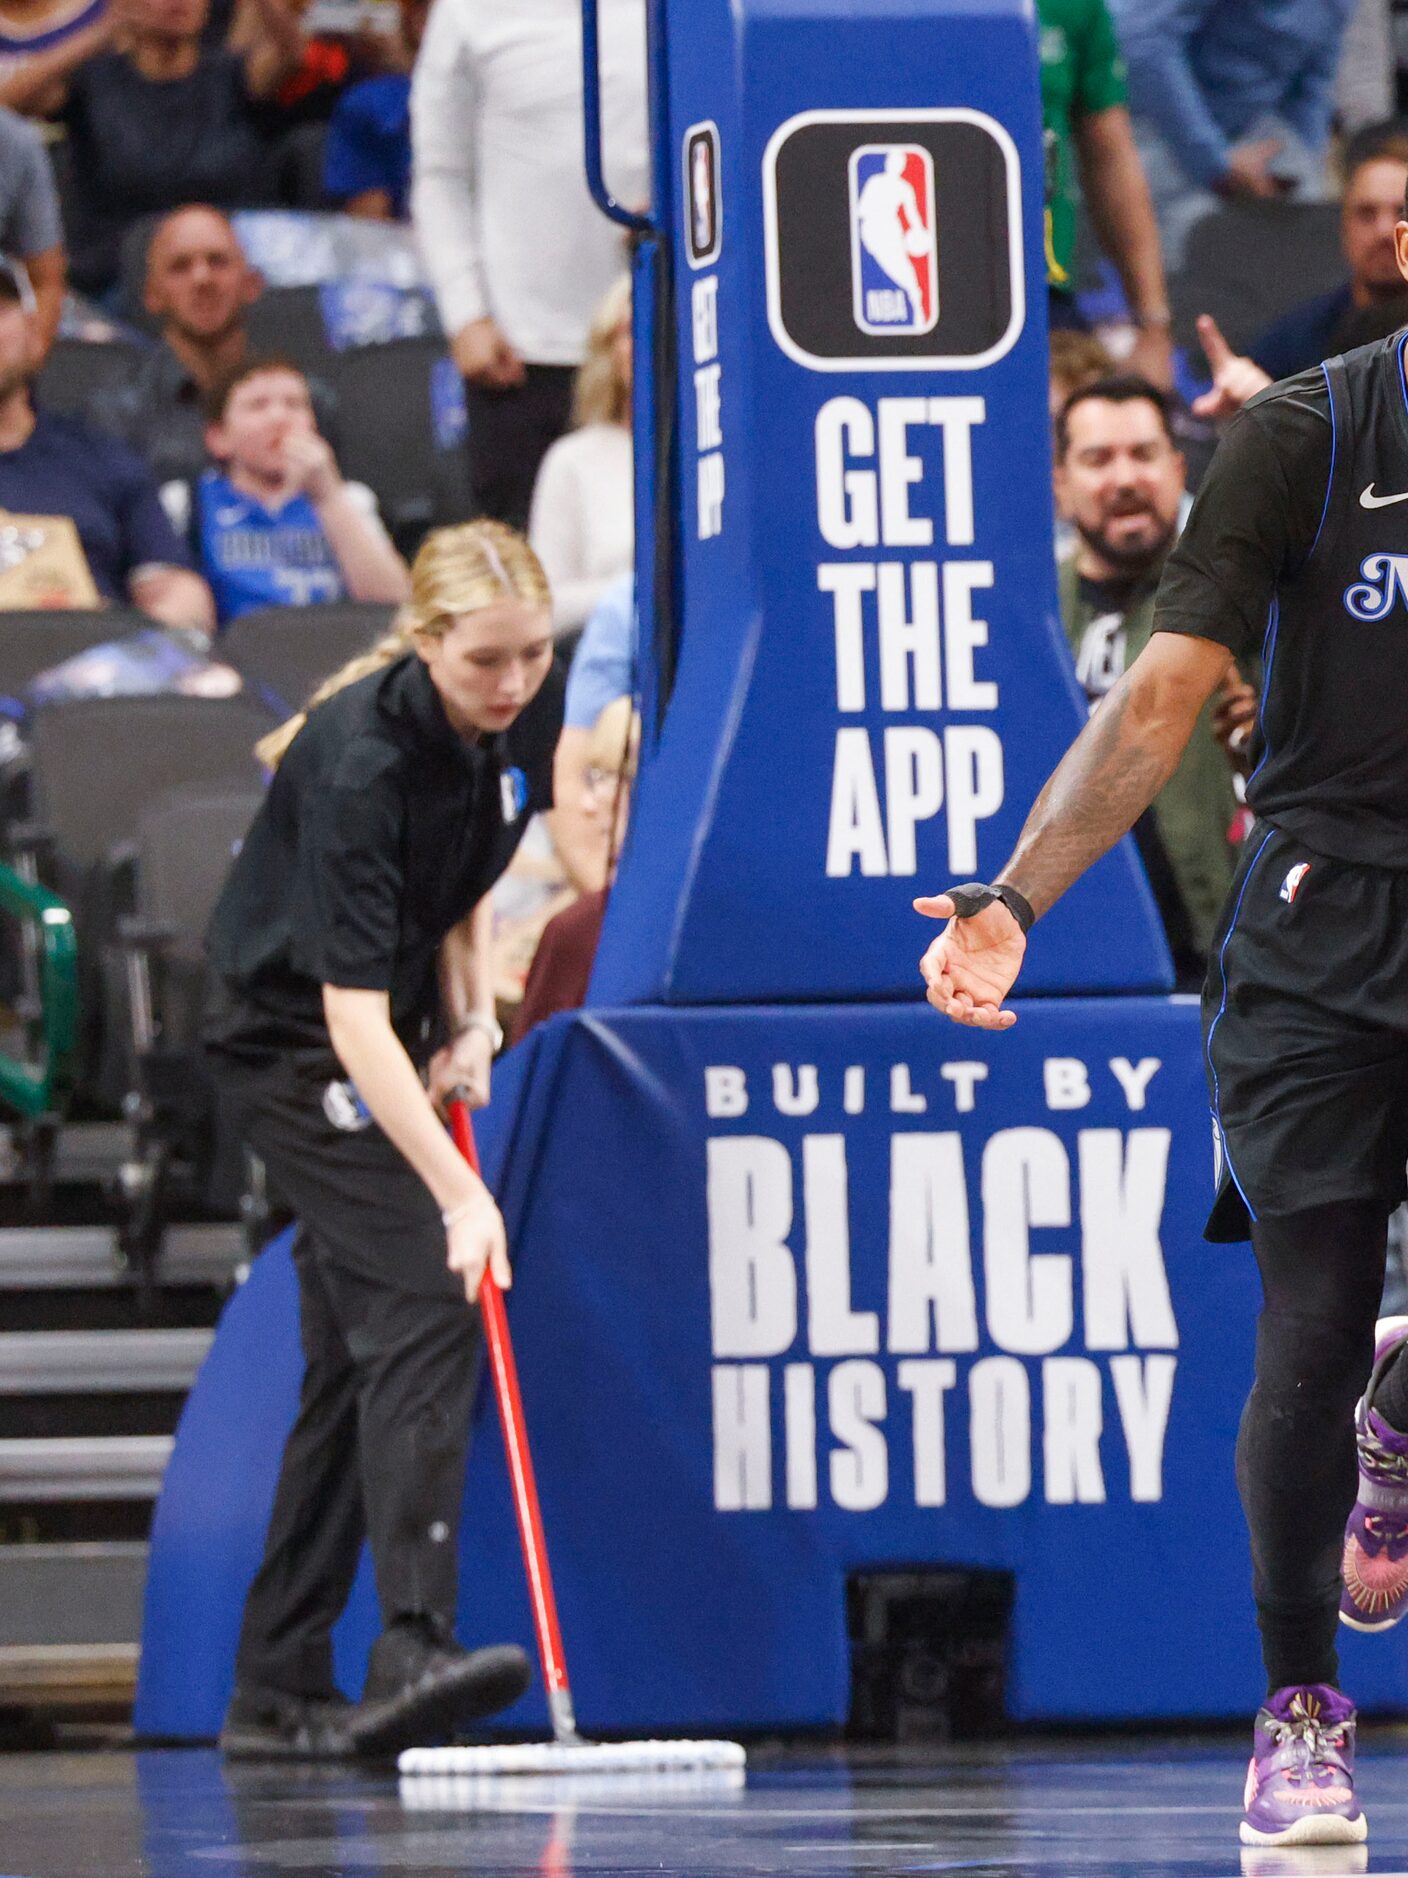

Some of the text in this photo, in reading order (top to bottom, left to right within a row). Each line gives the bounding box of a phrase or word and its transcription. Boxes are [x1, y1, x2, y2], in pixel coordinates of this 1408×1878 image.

[814, 395, 986, 549] GET
[816, 560, 998, 712] THE
[825, 724, 1005, 878] APP
[704, 1056, 1162, 1118] BUILT BY
[706, 1125, 1180, 1358] BLACK
[711, 1354, 1178, 1512] HISTORY
